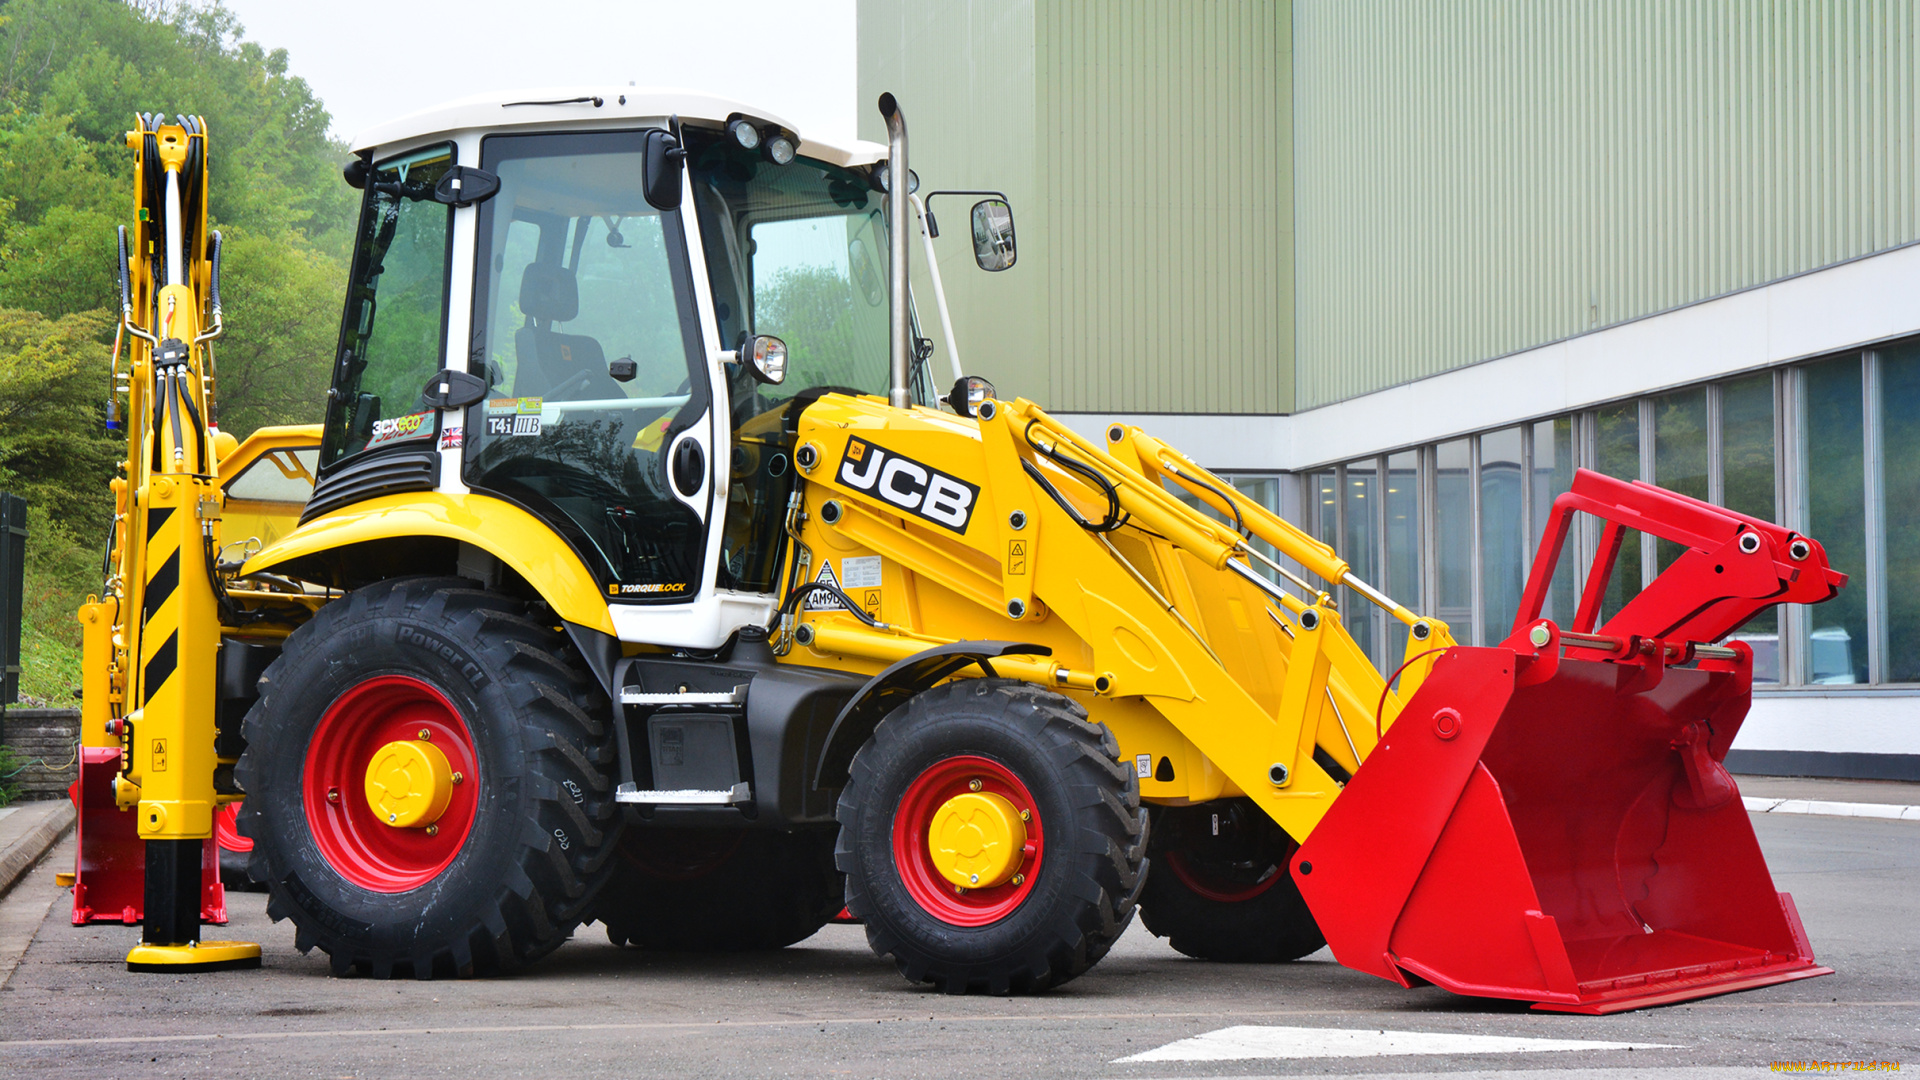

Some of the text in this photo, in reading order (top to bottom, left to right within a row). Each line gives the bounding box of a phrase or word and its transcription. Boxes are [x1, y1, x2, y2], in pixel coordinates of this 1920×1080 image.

[488, 418, 511, 434] T4i
[841, 449, 972, 527] JCB
[621, 583, 686, 593] TORQUELOCK
[398, 626, 484, 689] Power CL
